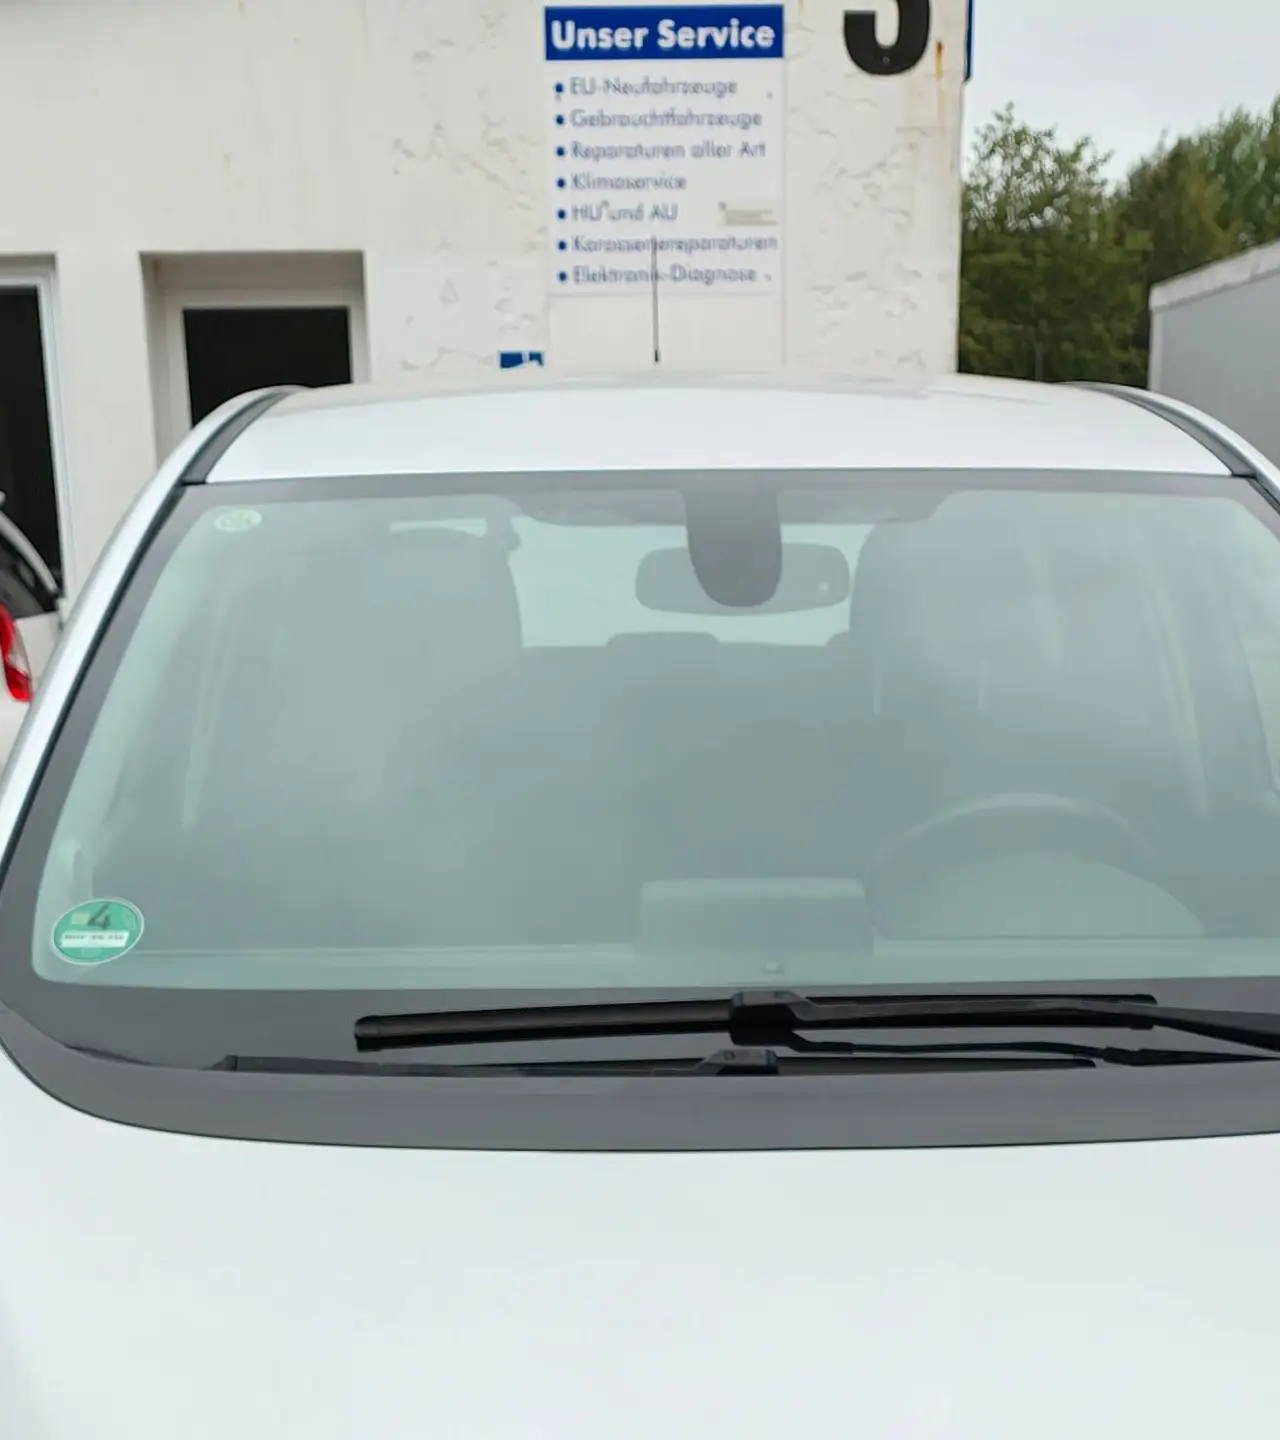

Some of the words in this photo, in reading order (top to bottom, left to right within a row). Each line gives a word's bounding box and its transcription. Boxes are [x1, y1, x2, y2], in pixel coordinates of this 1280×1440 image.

[551, 20, 649, 49] Unser
[657, 18, 775, 48] Service
[570, 76, 738, 99] EU-Neufahrzeuge
[571, 107, 763, 130] Gebrauchtfahrzeuge
[571, 140, 686, 162] Reparaturen
[690, 139, 732, 157] aller
[739, 141, 767, 157] Art
[571, 171, 687, 190] Klimaservice
[572, 204, 603, 221] HU
[608, 202, 644, 221] und
[650, 203, 679, 221] AU
[87, 903, 111, 930] 4
